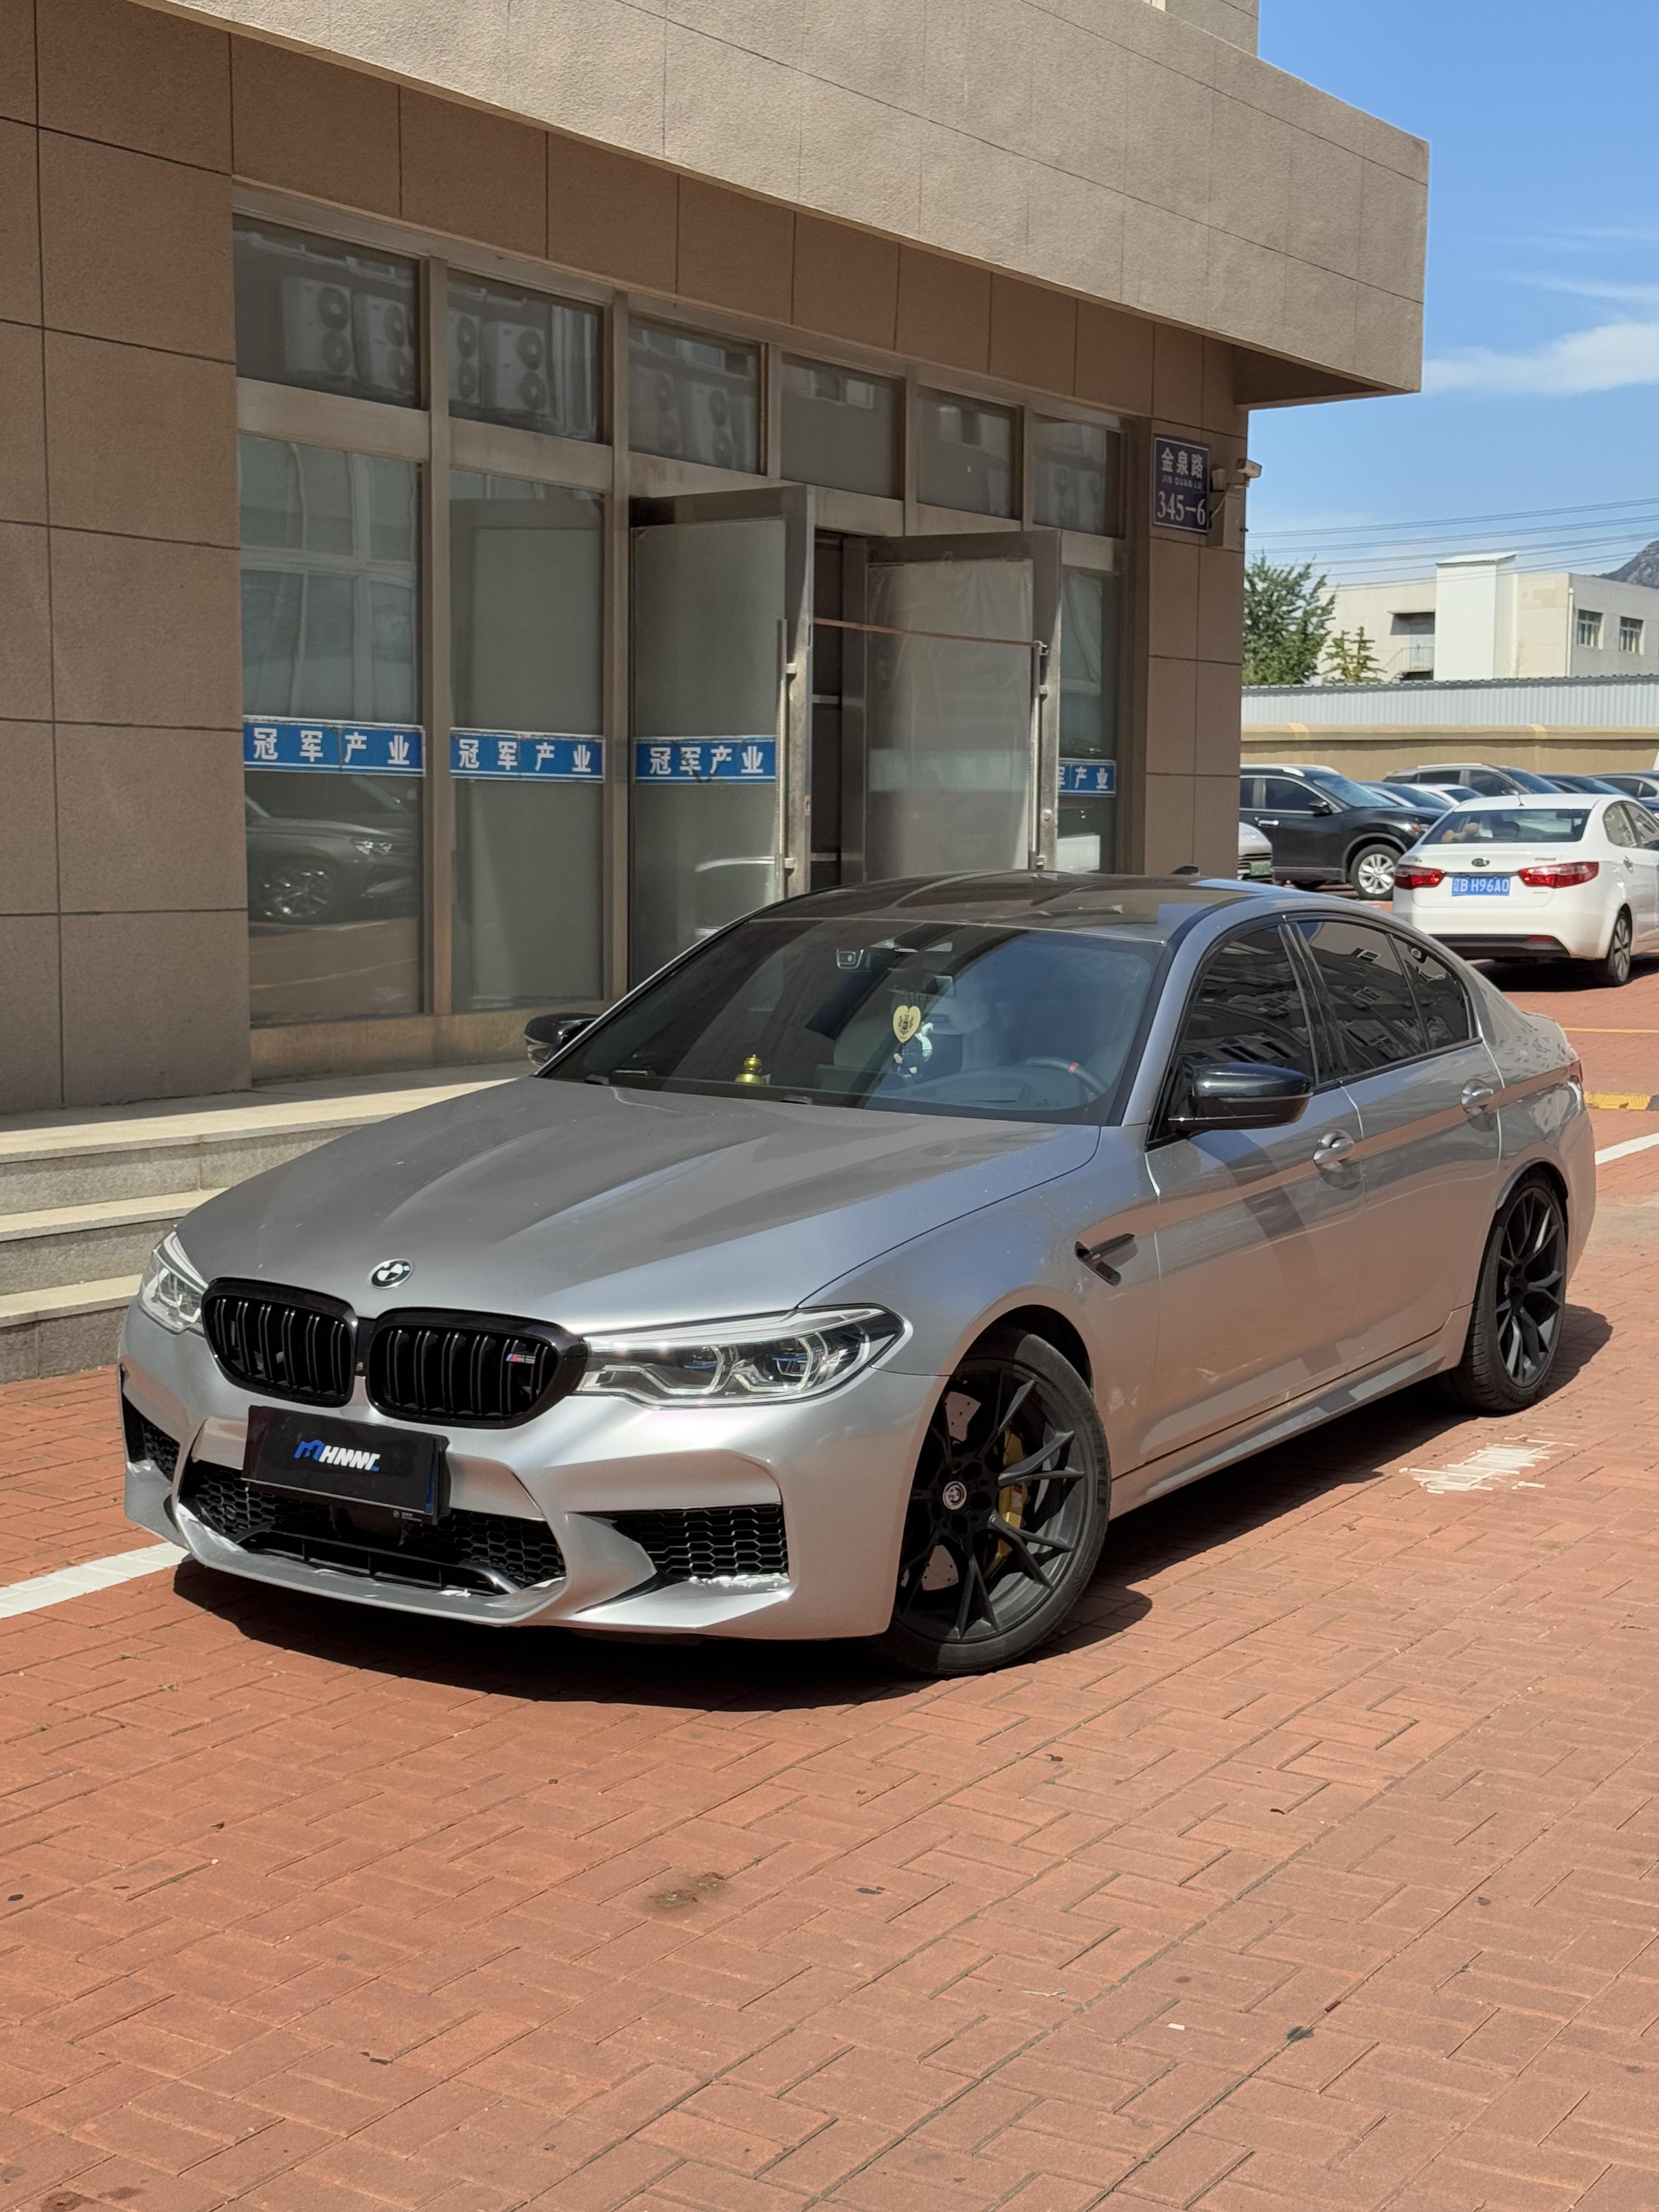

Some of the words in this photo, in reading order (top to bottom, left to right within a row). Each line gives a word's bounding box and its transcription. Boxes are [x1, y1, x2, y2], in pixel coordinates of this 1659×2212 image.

[1161, 447, 1203, 479] 金泉路
[1156, 490, 1206, 525] 345-6
[253, 727, 410, 765] 冠军产业
[459, 738, 591, 773] 冠军产业
[650, 745, 764, 775] 冠军产业
